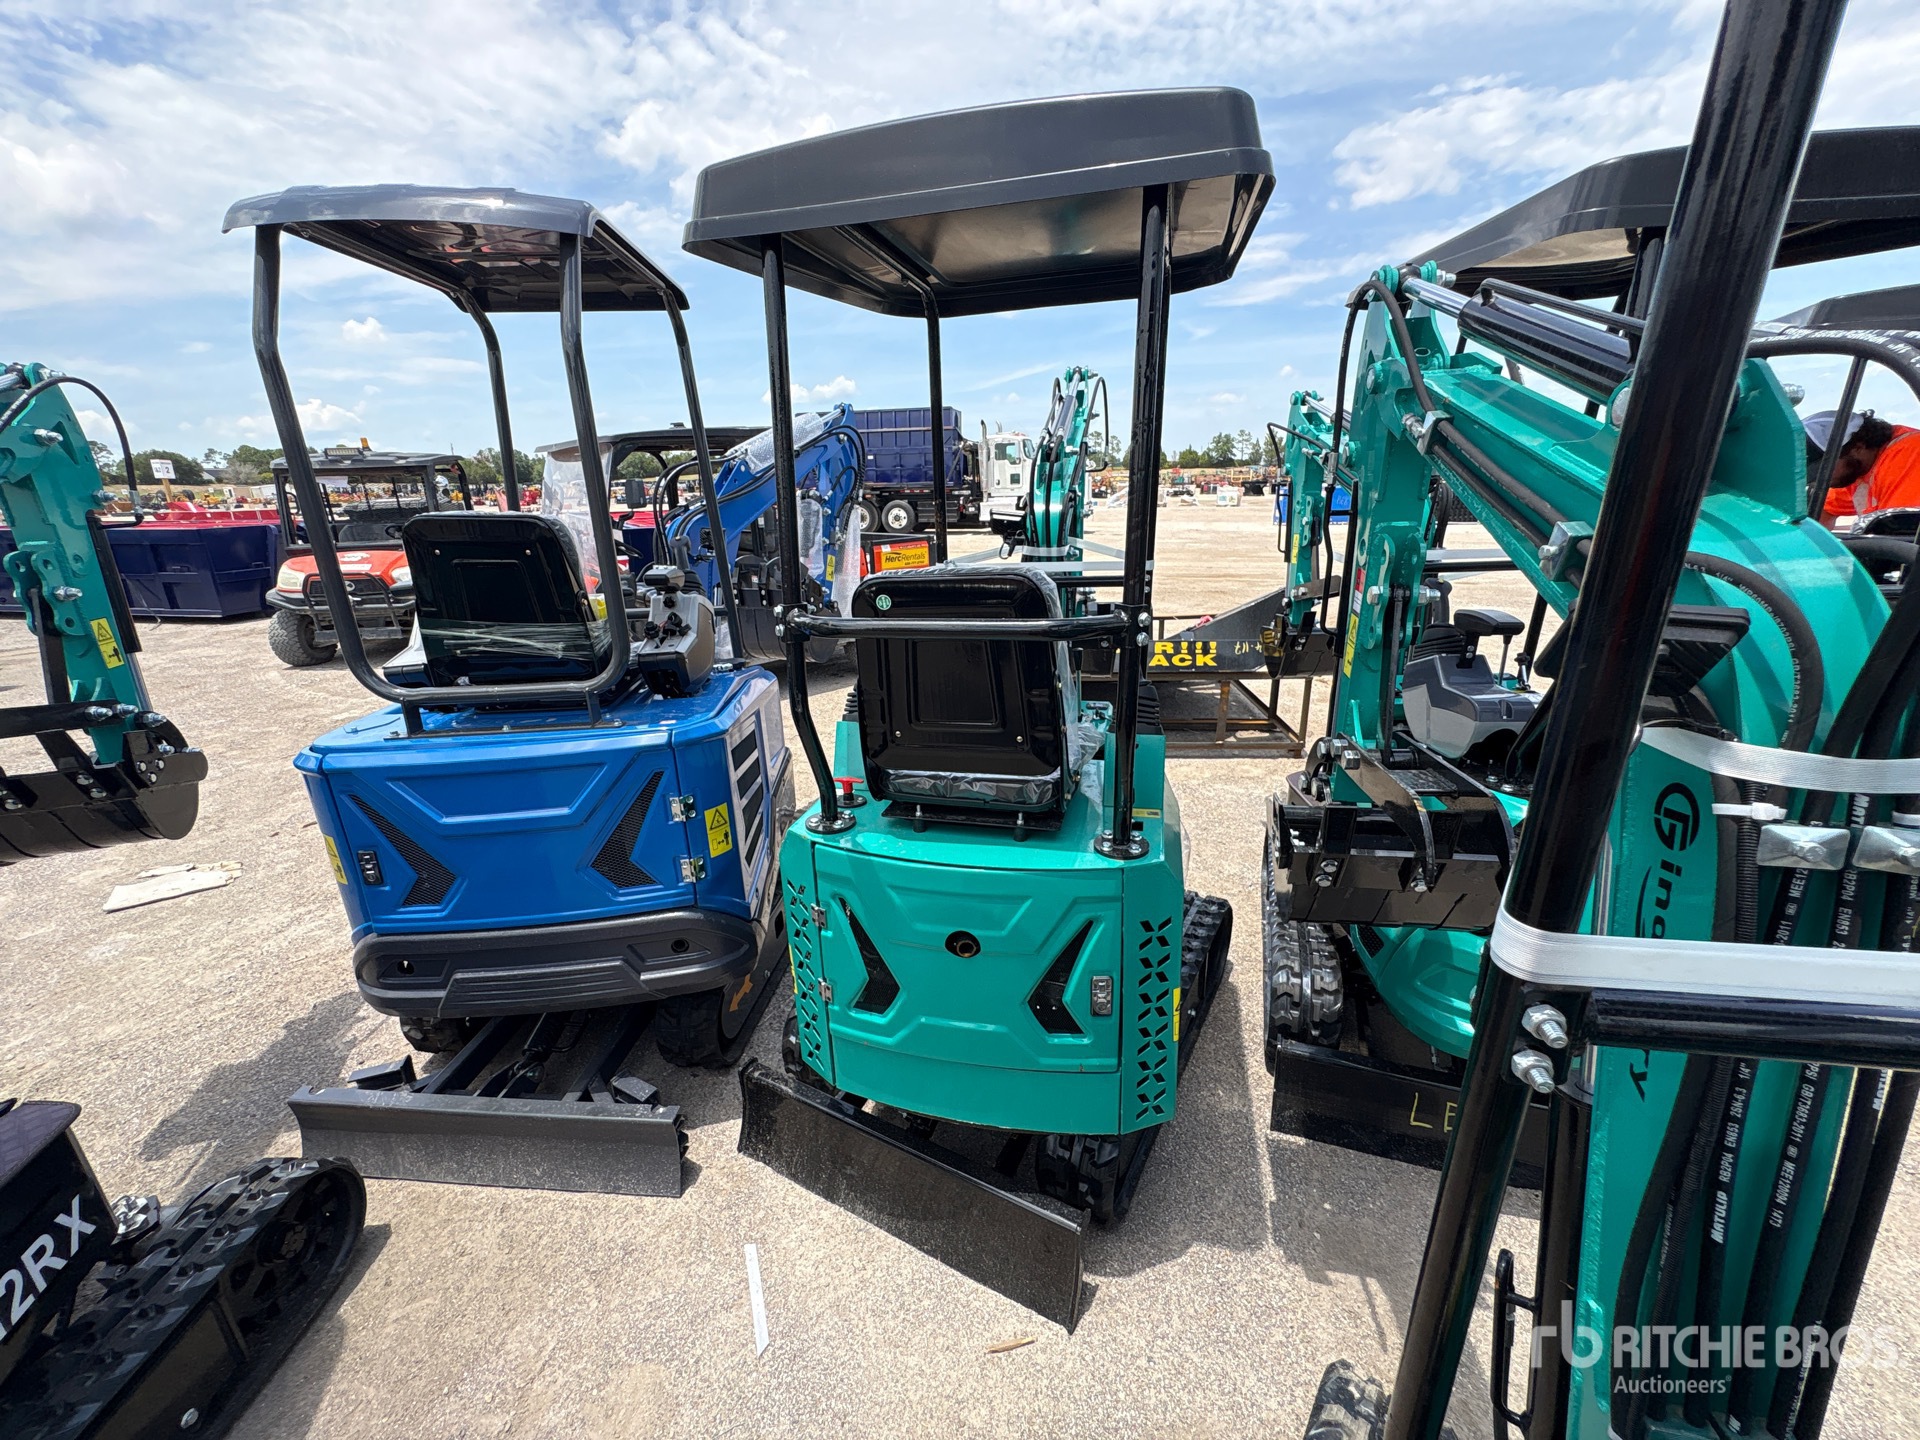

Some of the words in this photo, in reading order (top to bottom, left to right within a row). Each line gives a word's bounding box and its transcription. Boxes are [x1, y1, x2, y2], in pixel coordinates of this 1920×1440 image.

[1149, 653, 1217, 666] ACK
[1724, 1122, 1740, 1148] EN853
[1718, 1152, 1736, 1183] RB2P04
[0, 1194, 97, 1341] 2RX
